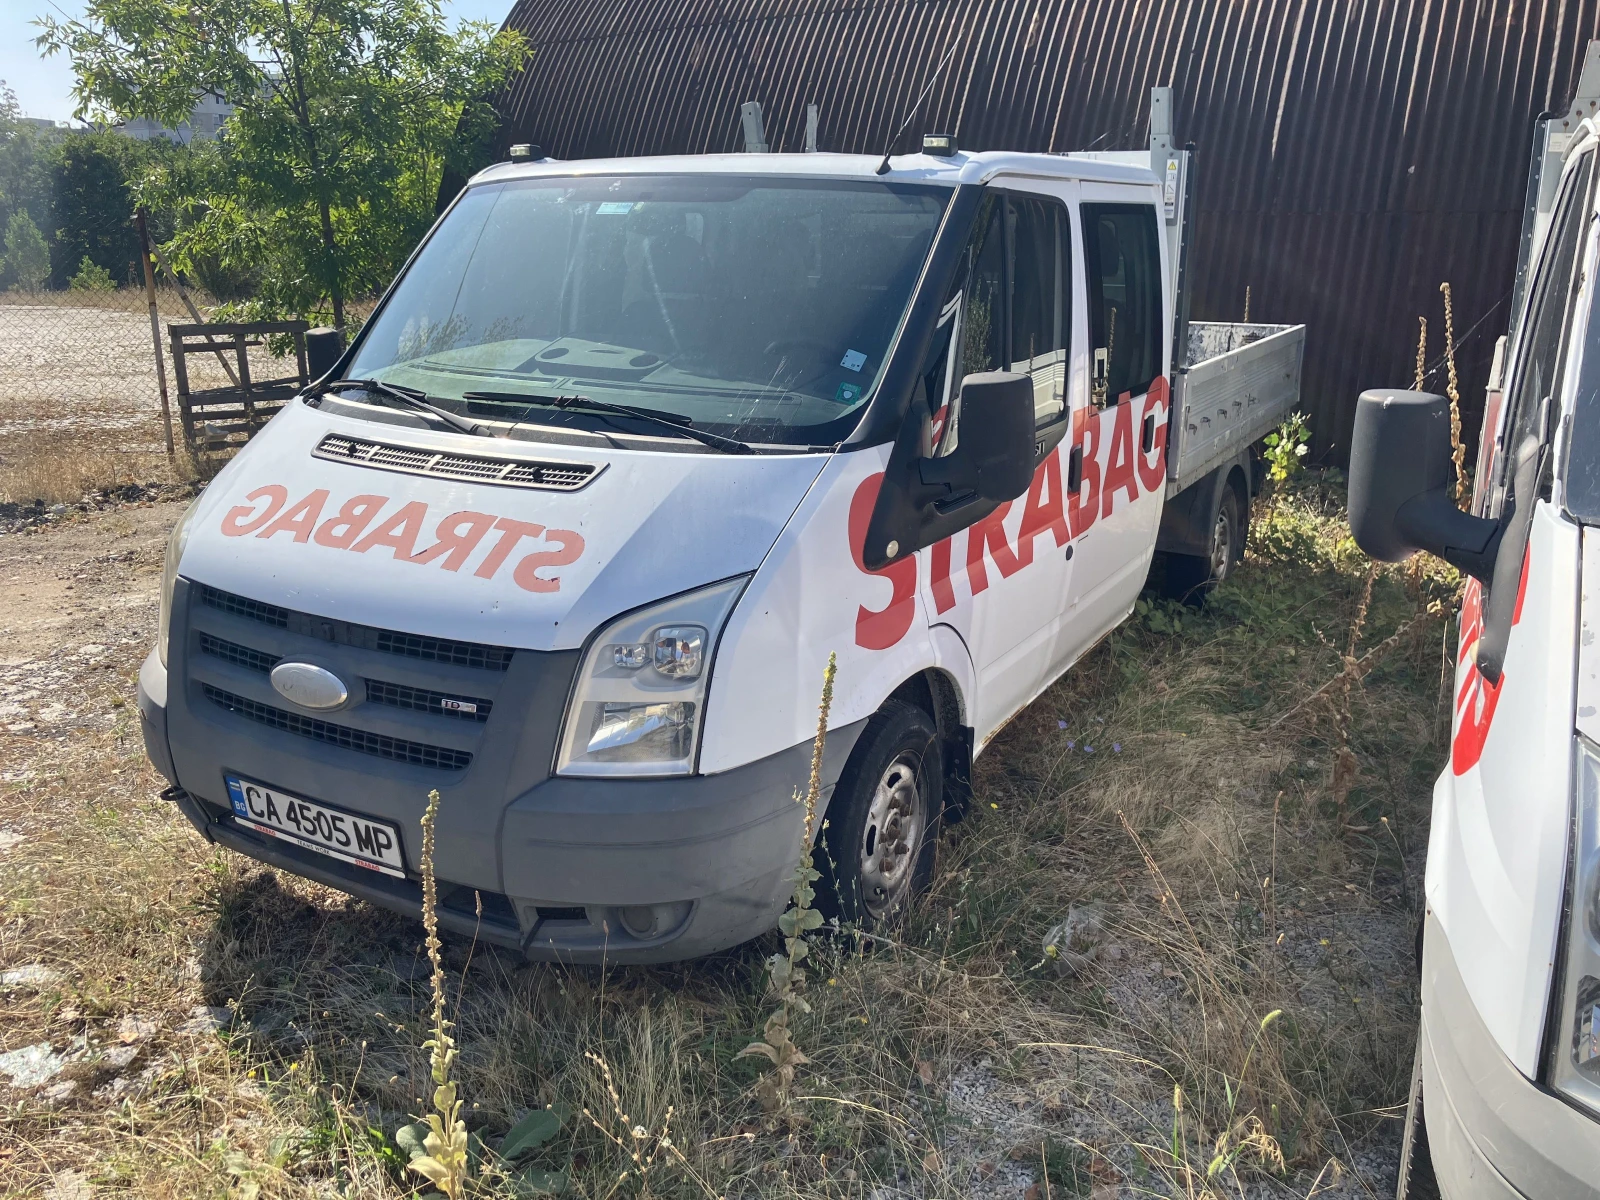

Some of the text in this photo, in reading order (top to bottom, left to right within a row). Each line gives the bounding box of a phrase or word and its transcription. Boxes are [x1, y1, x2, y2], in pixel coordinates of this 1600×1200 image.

[234, 801, 246, 812] BG
[245, 786, 393, 858] CA 4505 MP
[254, 824, 277, 837] STRABAG
[355, 859, 380, 872] STRABAG
